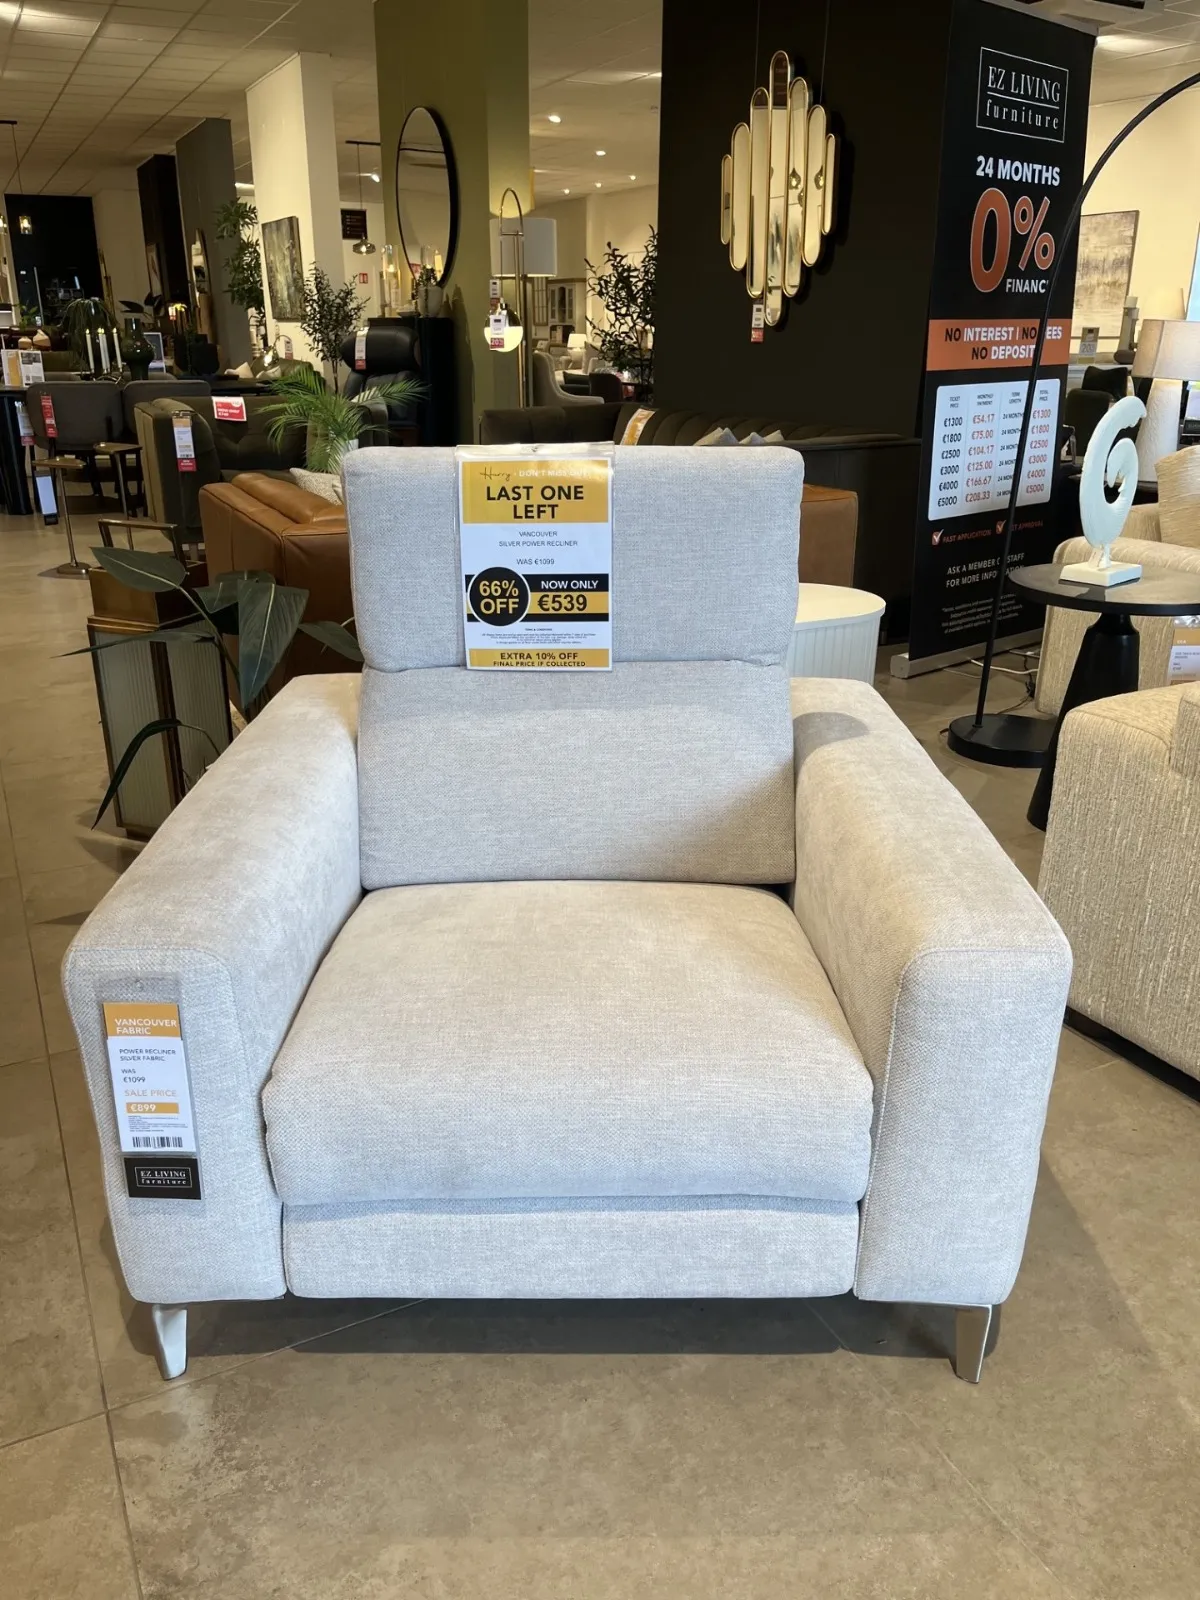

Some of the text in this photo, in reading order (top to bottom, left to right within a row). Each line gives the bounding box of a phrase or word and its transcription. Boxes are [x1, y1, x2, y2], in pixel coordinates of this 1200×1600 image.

[987, 65, 1061, 103] EZ LIVING
[986, 98, 1059, 130] furniture
[976, 154, 1061, 187] 24 MONTHS
[970, 187, 1056, 293] 0%
[1005, 278, 1049, 294] FINANC
[944, 326, 1063, 342] NO INTEREST NO EES
[971, 344, 1036, 360] NO DEPOSIT
[943, 416, 963, 427] €1300
[972, 413, 996, 425] €54.17
[1032, 408, 1052, 419] €1300
[942, 432, 962, 443] €1800
[971, 429, 994, 440] €75.00
[1031, 424, 1050, 435] €1800
[941, 448, 961, 460] €2500
[968, 444, 995, 456] €104.17
[1029, 439, 1049, 450] €2500
[518, 469, 545, 477] DON'T
[940, 464, 960, 476] €3000
[967, 460, 993, 472] €125.00
[1028, 454, 1048, 465] €3000
[479, 466, 512, 482] Hurry
[939, 480, 959, 492] €4000
[966, 475, 992, 488] €166.67
[1026, 468, 1046, 479] €4000
[486, 485, 584, 501] LAST ONE
[937, 495, 958, 507] €5000
[965, 491, 991, 503] €208.33
[1025, 483, 1045, 494] €5000
[513, 503, 559, 519] LEFT
[518, 530, 558, 538] VANCOUVER
[946, 565, 961, 575] ASK
[962, 563, 967, 572] A
[968, 559, 996, 571] MEMBER
[1006, 552, 1025, 564] STAFF
[479, 579, 519, 597] 66%
[541, 580, 599, 590] NOW ONLY
[945, 578, 960, 589] FOR
[961, 573, 980, 585] MORE
[480, 598, 520, 614] OFF
[537, 593, 588, 612] €539
[500, 652, 578, 660] EXTRA 10% OFF
[114, 1018, 177, 1028] VANCOUVER
[116, 1026, 152, 1035] FABRIC
[124, 1089, 177, 1097] SALE PRICE
[130, 1103, 157, 1112] €899
[154, 1170, 186, 1178] LIVING
